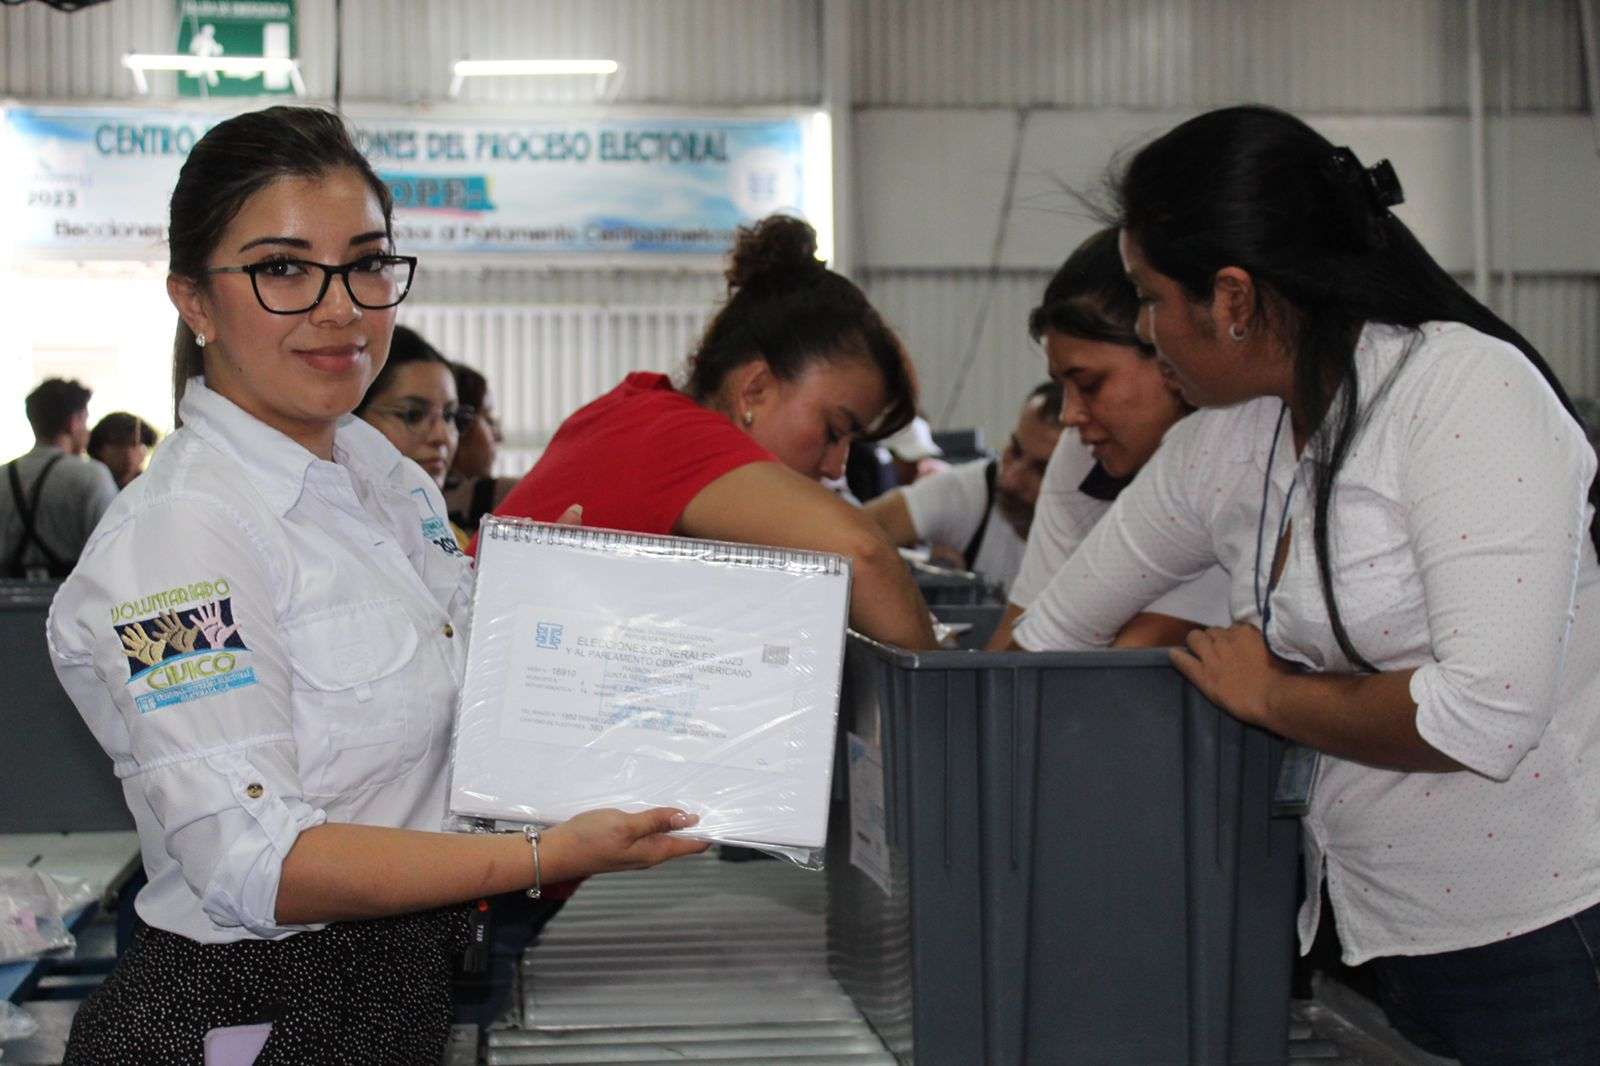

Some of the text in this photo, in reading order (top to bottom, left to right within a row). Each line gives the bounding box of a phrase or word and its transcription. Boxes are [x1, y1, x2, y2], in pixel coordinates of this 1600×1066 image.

[95, 123, 728, 163] CENTRO ONES DEL PROCESO ELECTORAL
[389, 177, 465, 207] OPE
[111, 578, 231, 622] VOLUNTARIADO
[577, 636, 647, 654] ELECCIONES
[650, 646, 717, 661] GENERALES
[587, 649, 654, 666] PARLAMENTO
[655, 656, 753, 679] CENTAMERICANO
